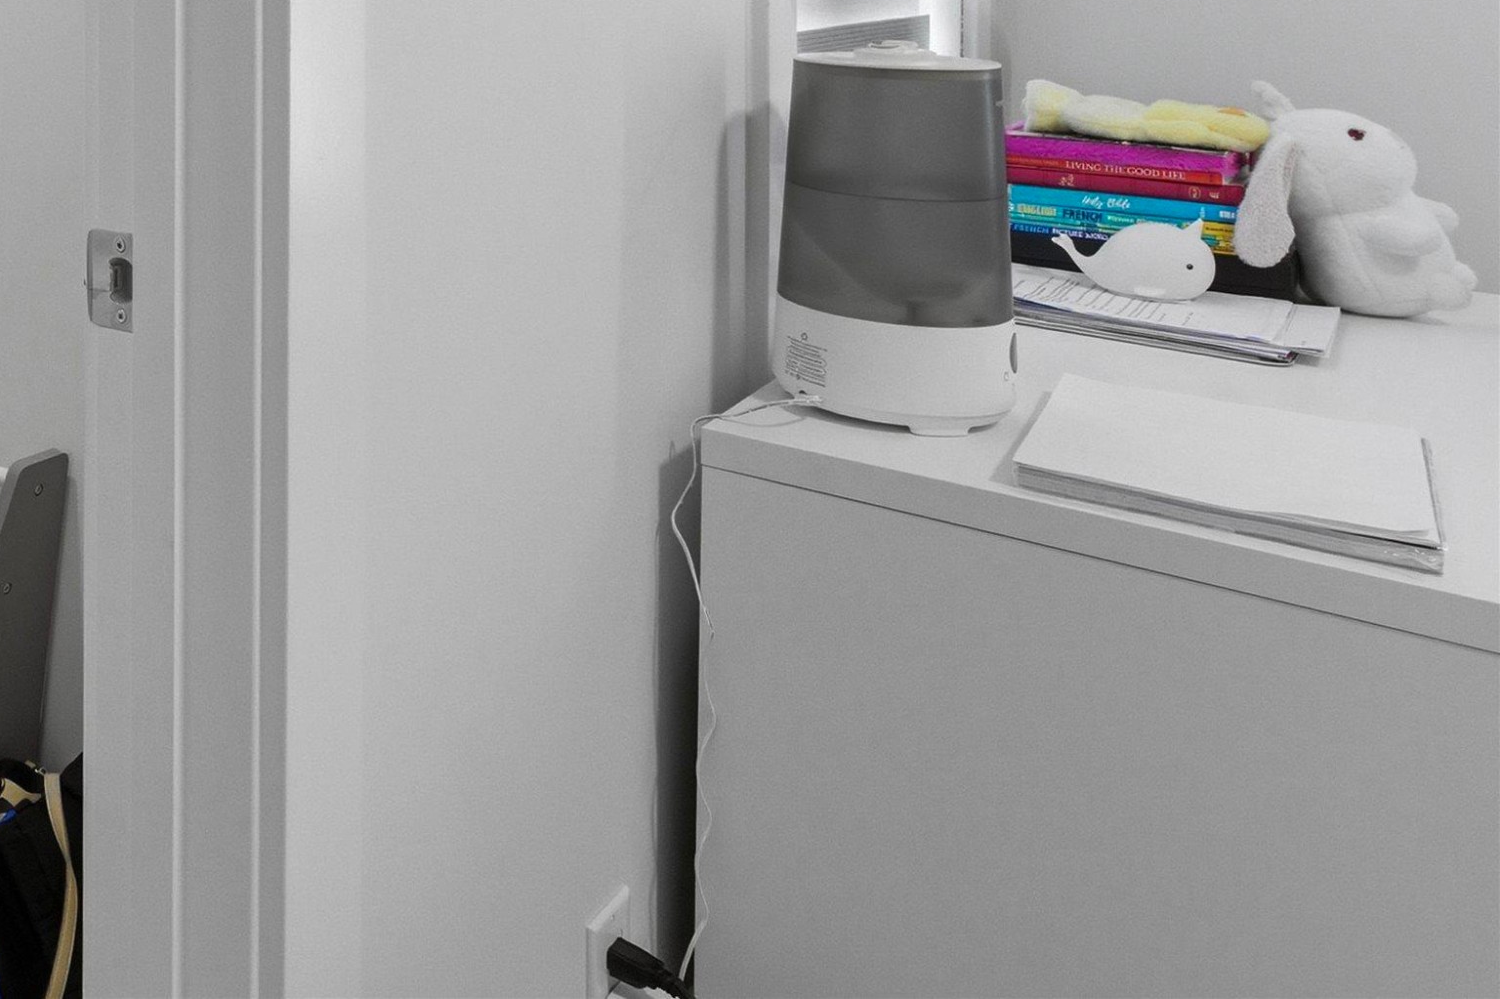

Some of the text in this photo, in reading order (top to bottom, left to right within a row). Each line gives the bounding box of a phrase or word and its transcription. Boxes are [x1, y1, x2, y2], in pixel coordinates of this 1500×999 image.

[1065, 160, 1101, 173] LIVING
[1104, 164, 1125, 175] THE
[1126, 166, 1161, 178] GOOD
[1162, 170, 1186, 180] LIFE
